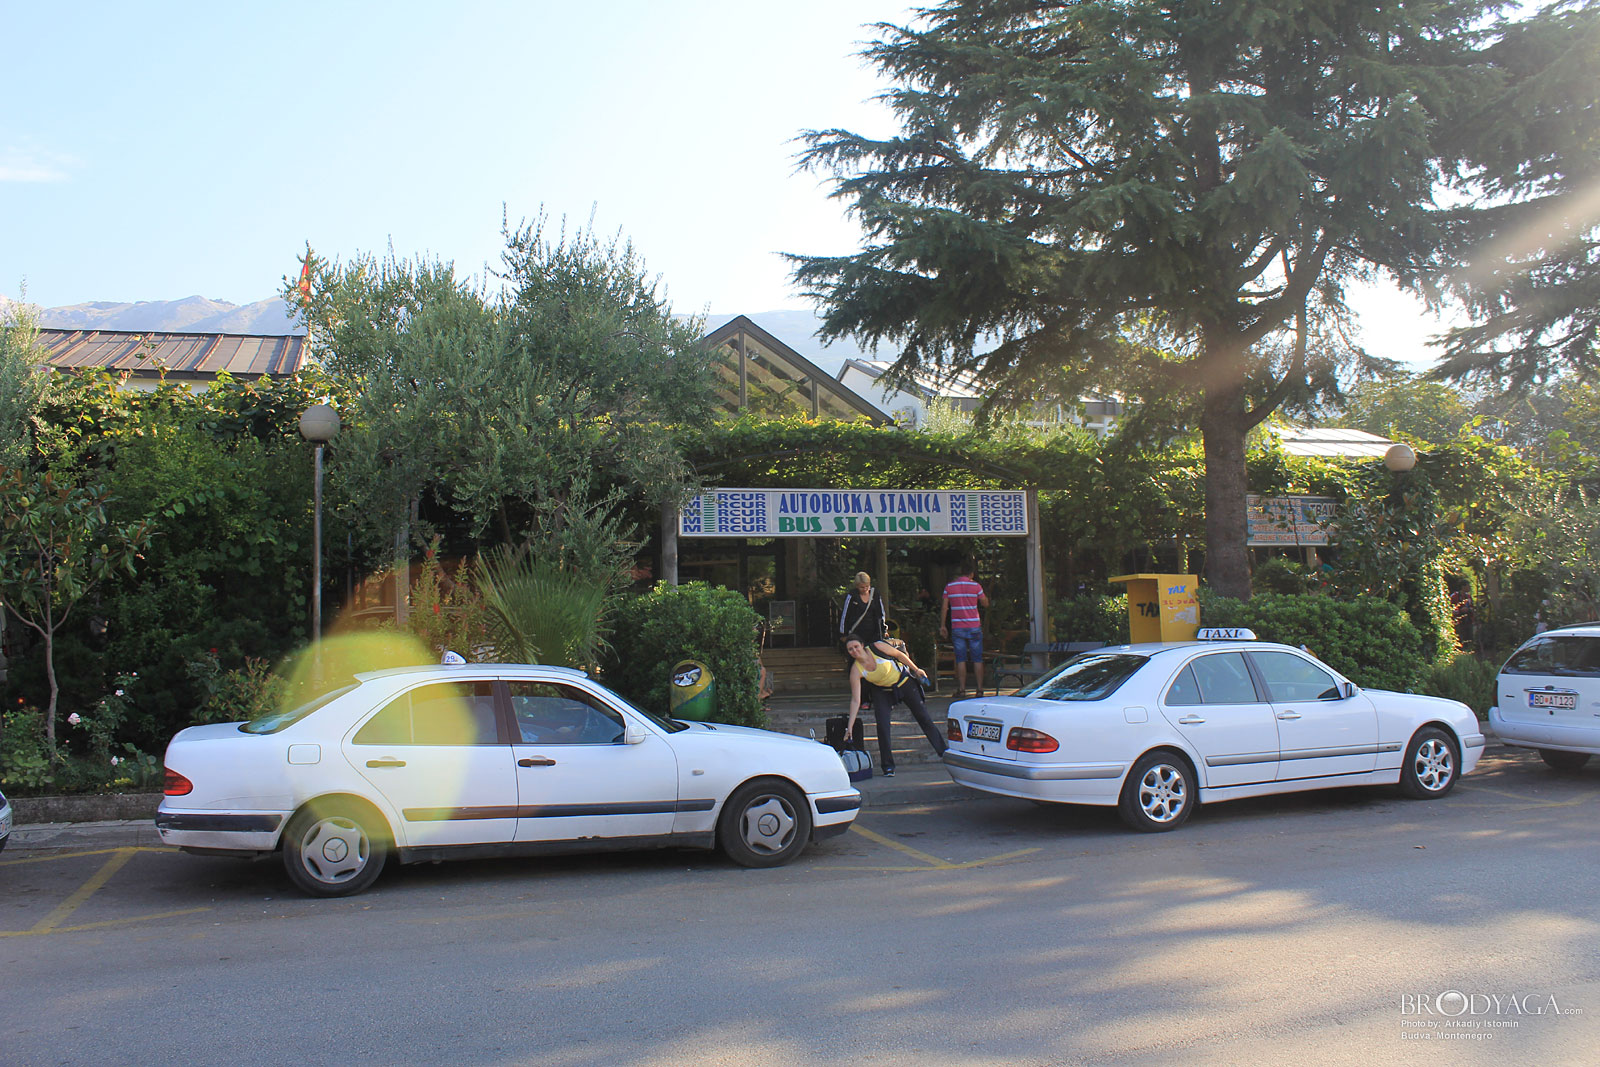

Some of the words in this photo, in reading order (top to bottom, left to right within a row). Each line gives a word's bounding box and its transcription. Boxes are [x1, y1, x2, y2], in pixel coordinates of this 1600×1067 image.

[778, 493, 874, 514] AUTOBUSKA
[879, 493, 941, 513] STANICA
[1310, 504, 1341, 518] TRAVE
[778, 516, 823, 532] BUS
[833, 516, 931, 532] STATION
[1203, 630, 1239, 638] TAXI
[1549, 696, 1574, 706] AT123
